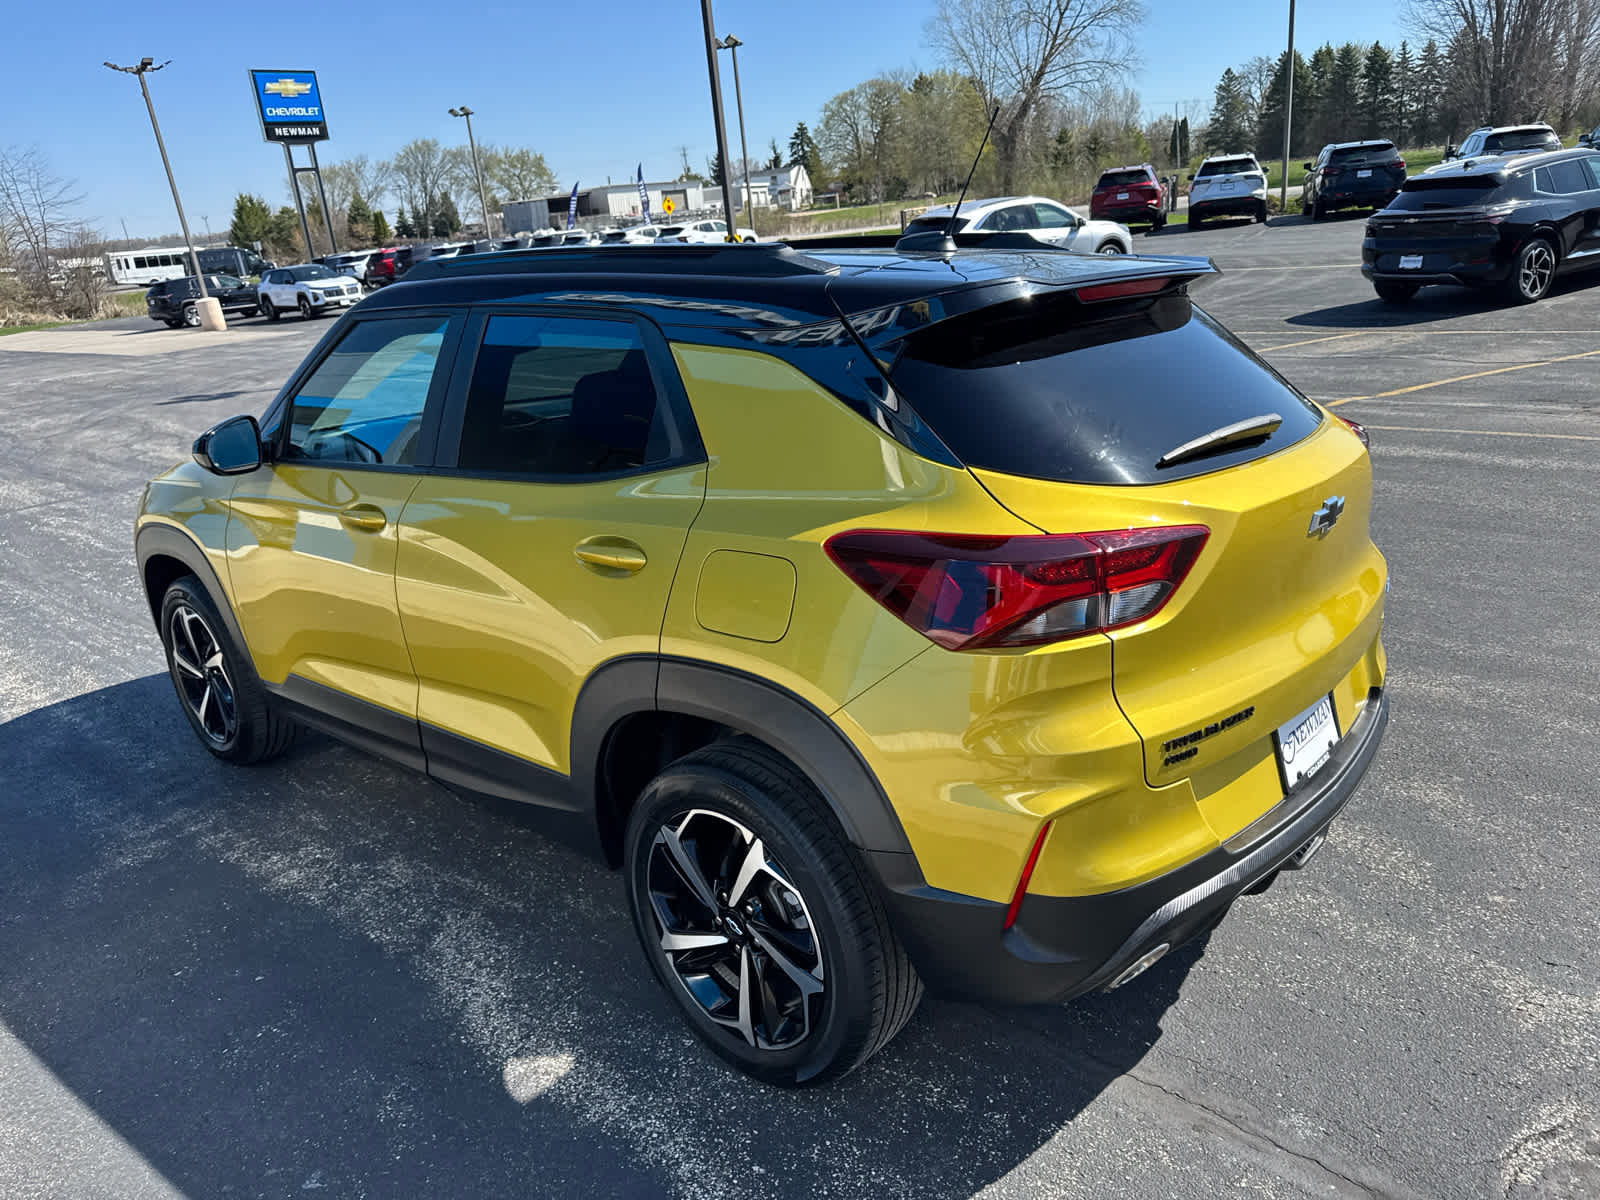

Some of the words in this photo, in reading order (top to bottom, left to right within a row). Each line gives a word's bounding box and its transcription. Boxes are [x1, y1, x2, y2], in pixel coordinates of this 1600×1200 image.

[266, 107, 319, 116] CHEVROLET
[275, 127, 320, 136] NEWMAN
[1162, 705, 1255, 752] TRAILBLAZER
[1293, 697, 1331, 745] NEWMAN
